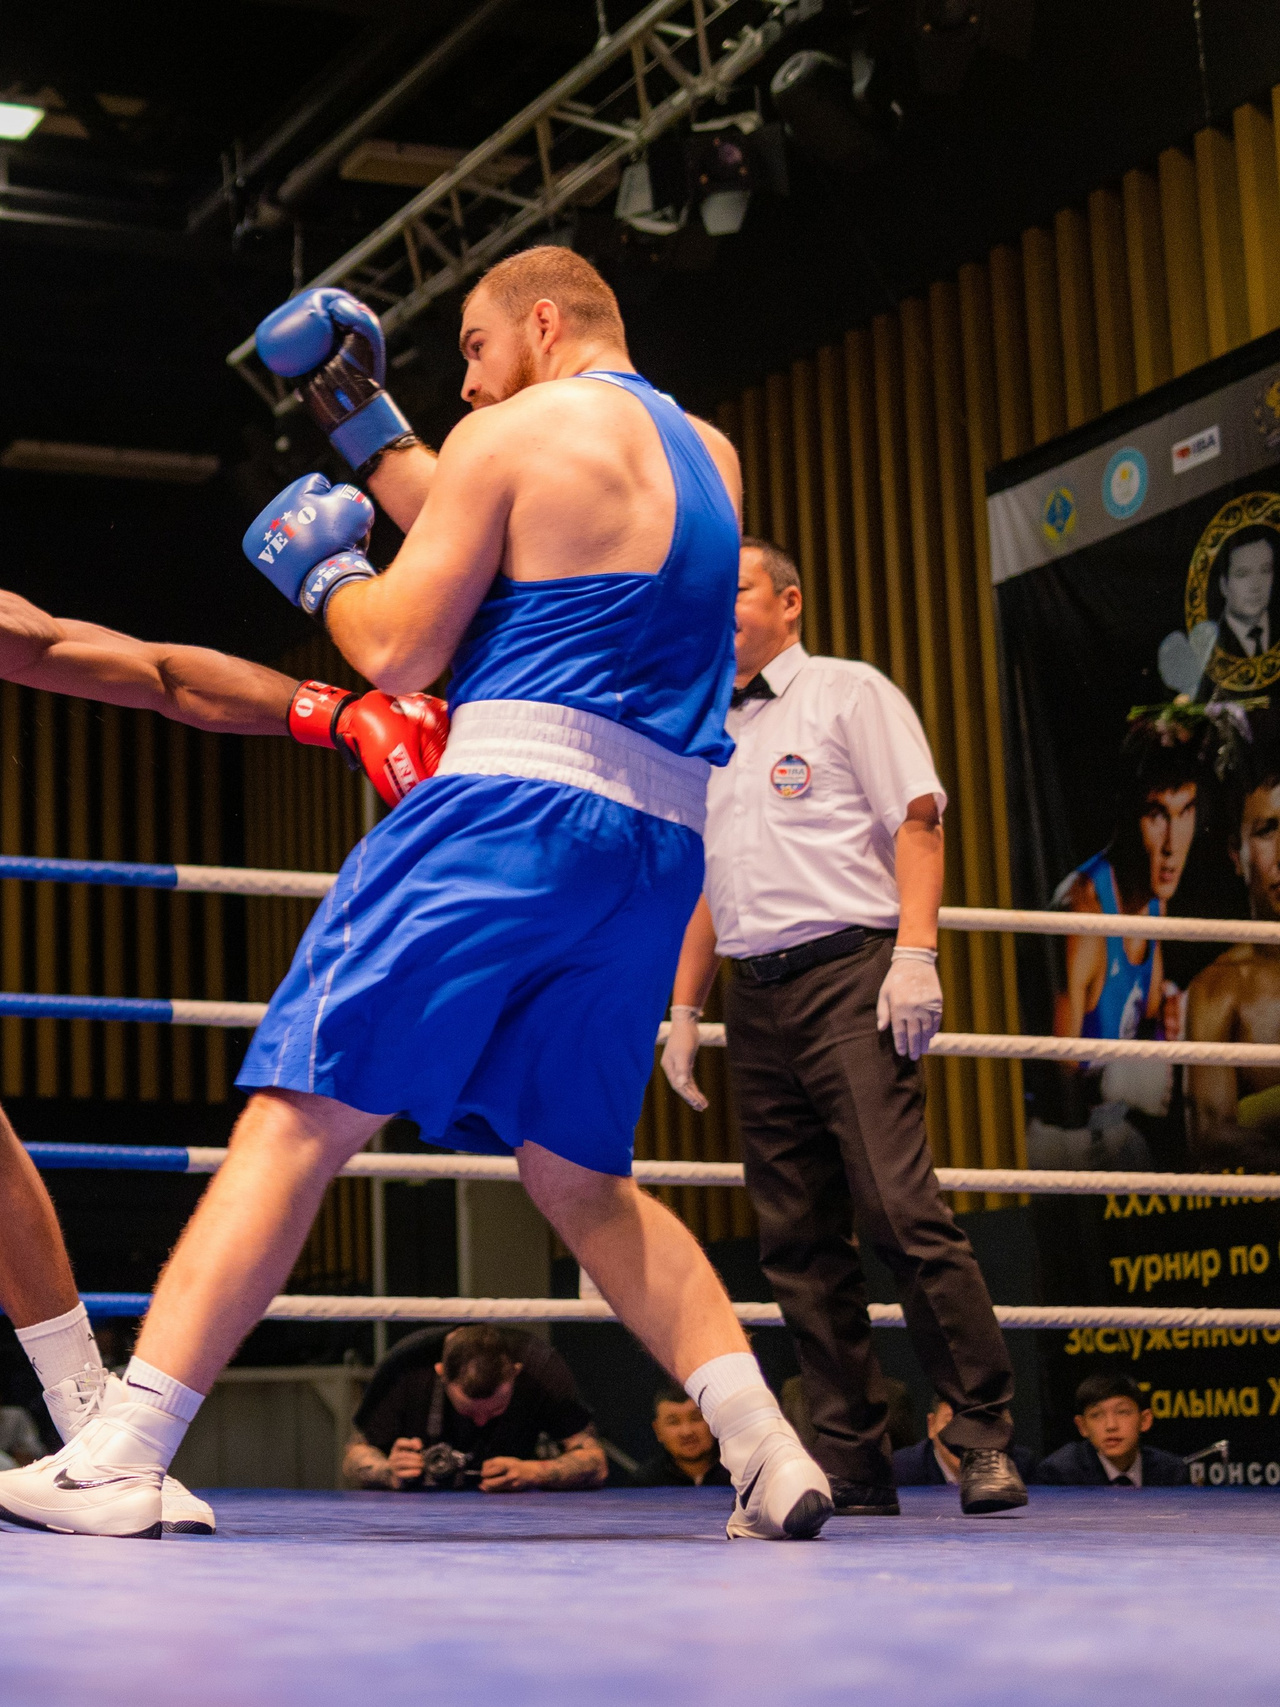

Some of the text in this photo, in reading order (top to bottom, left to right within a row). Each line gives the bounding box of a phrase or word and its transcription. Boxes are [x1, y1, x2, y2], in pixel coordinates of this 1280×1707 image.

[1109, 1248, 1221, 1293] турнир
[1229, 1244, 1270, 1277] по
[1137, 1381, 1260, 1419] алыма
